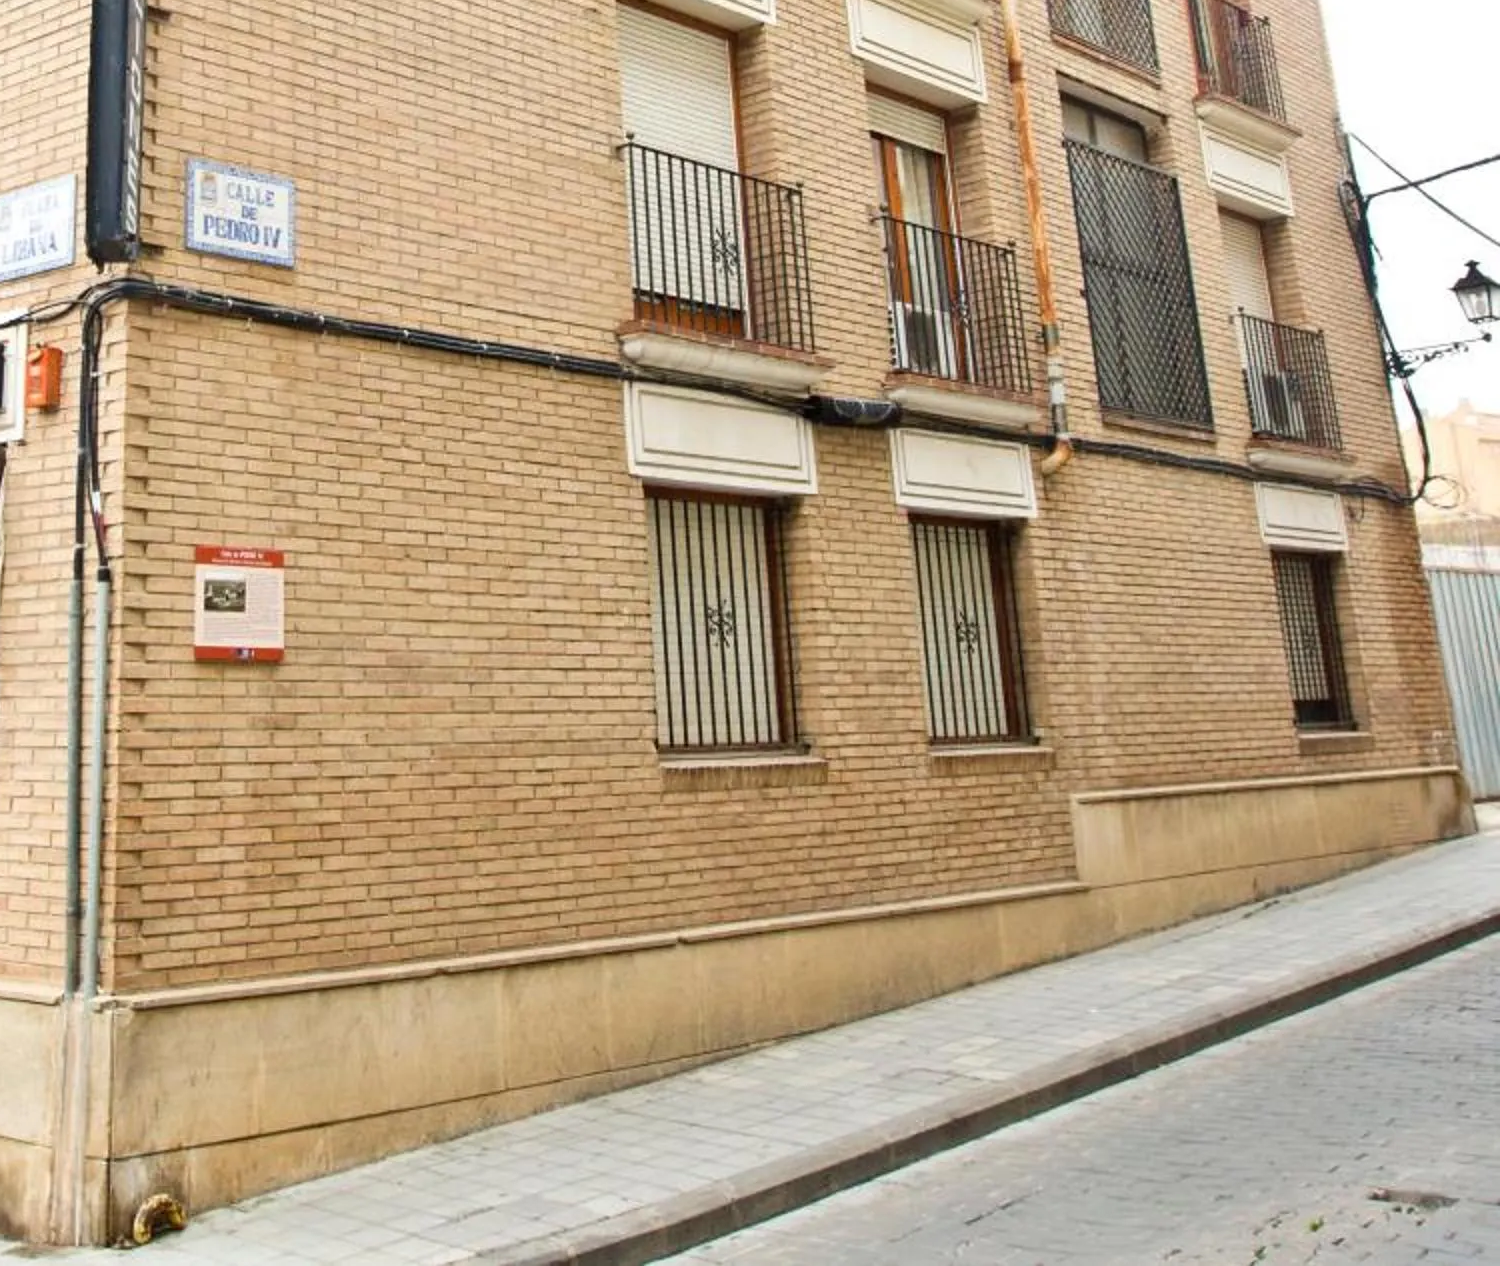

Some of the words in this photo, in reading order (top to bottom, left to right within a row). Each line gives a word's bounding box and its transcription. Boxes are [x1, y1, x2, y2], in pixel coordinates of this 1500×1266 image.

[227, 181, 276, 207] CALLE
[241, 204, 258, 221] DE
[203, 214, 260, 245] PEDRO
[263, 225, 281, 248] IV
